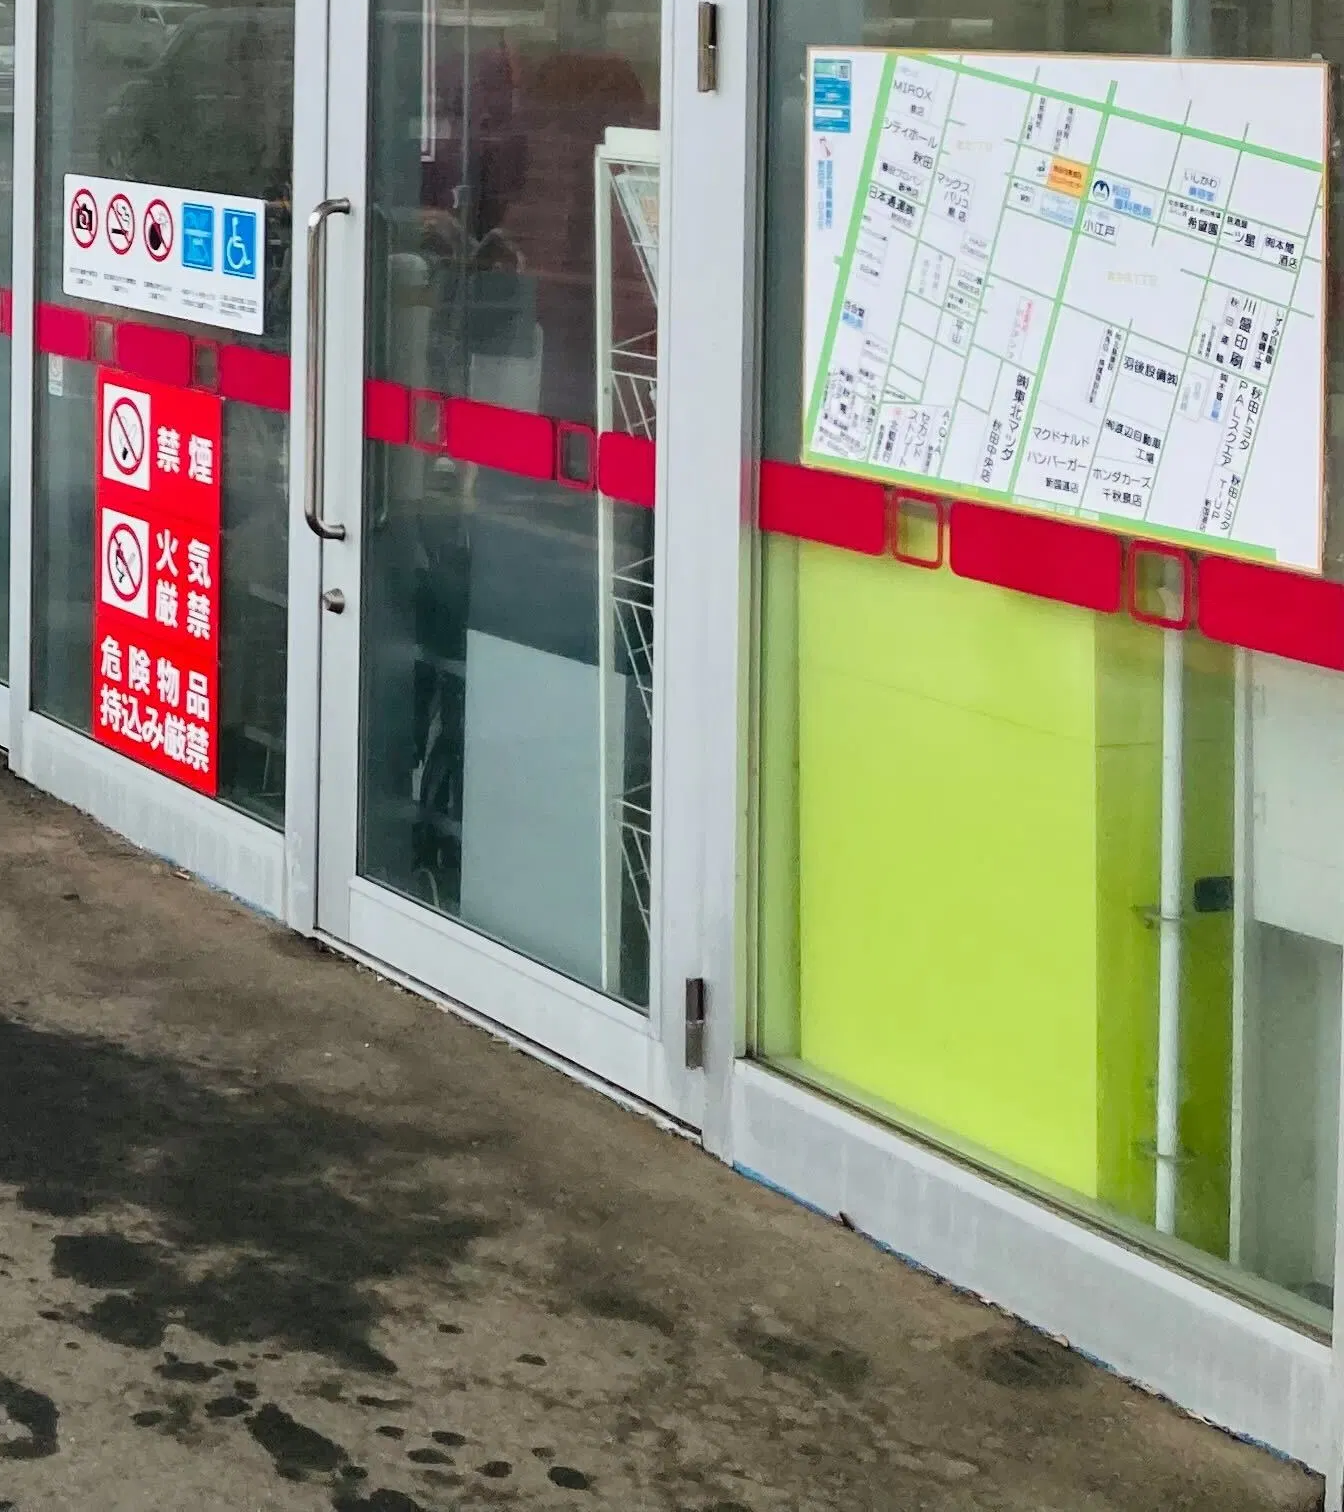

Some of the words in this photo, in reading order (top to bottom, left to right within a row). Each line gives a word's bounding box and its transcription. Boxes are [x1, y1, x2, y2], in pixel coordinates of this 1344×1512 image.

[155, 426, 214, 487] 禁煙
[1027, 451, 1088, 472] ハンバーガー
[1032, 426, 1090, 448] マクドナルド
[1093, 468, 1151, 490] ホンダカーズ
[155, 527, 212, 588] 火気
[154, 584, 212, 641] 厳禁
[99, 633, 211, 721] 危険物品
[99, 687, 211, 774] 持込み厳禁
